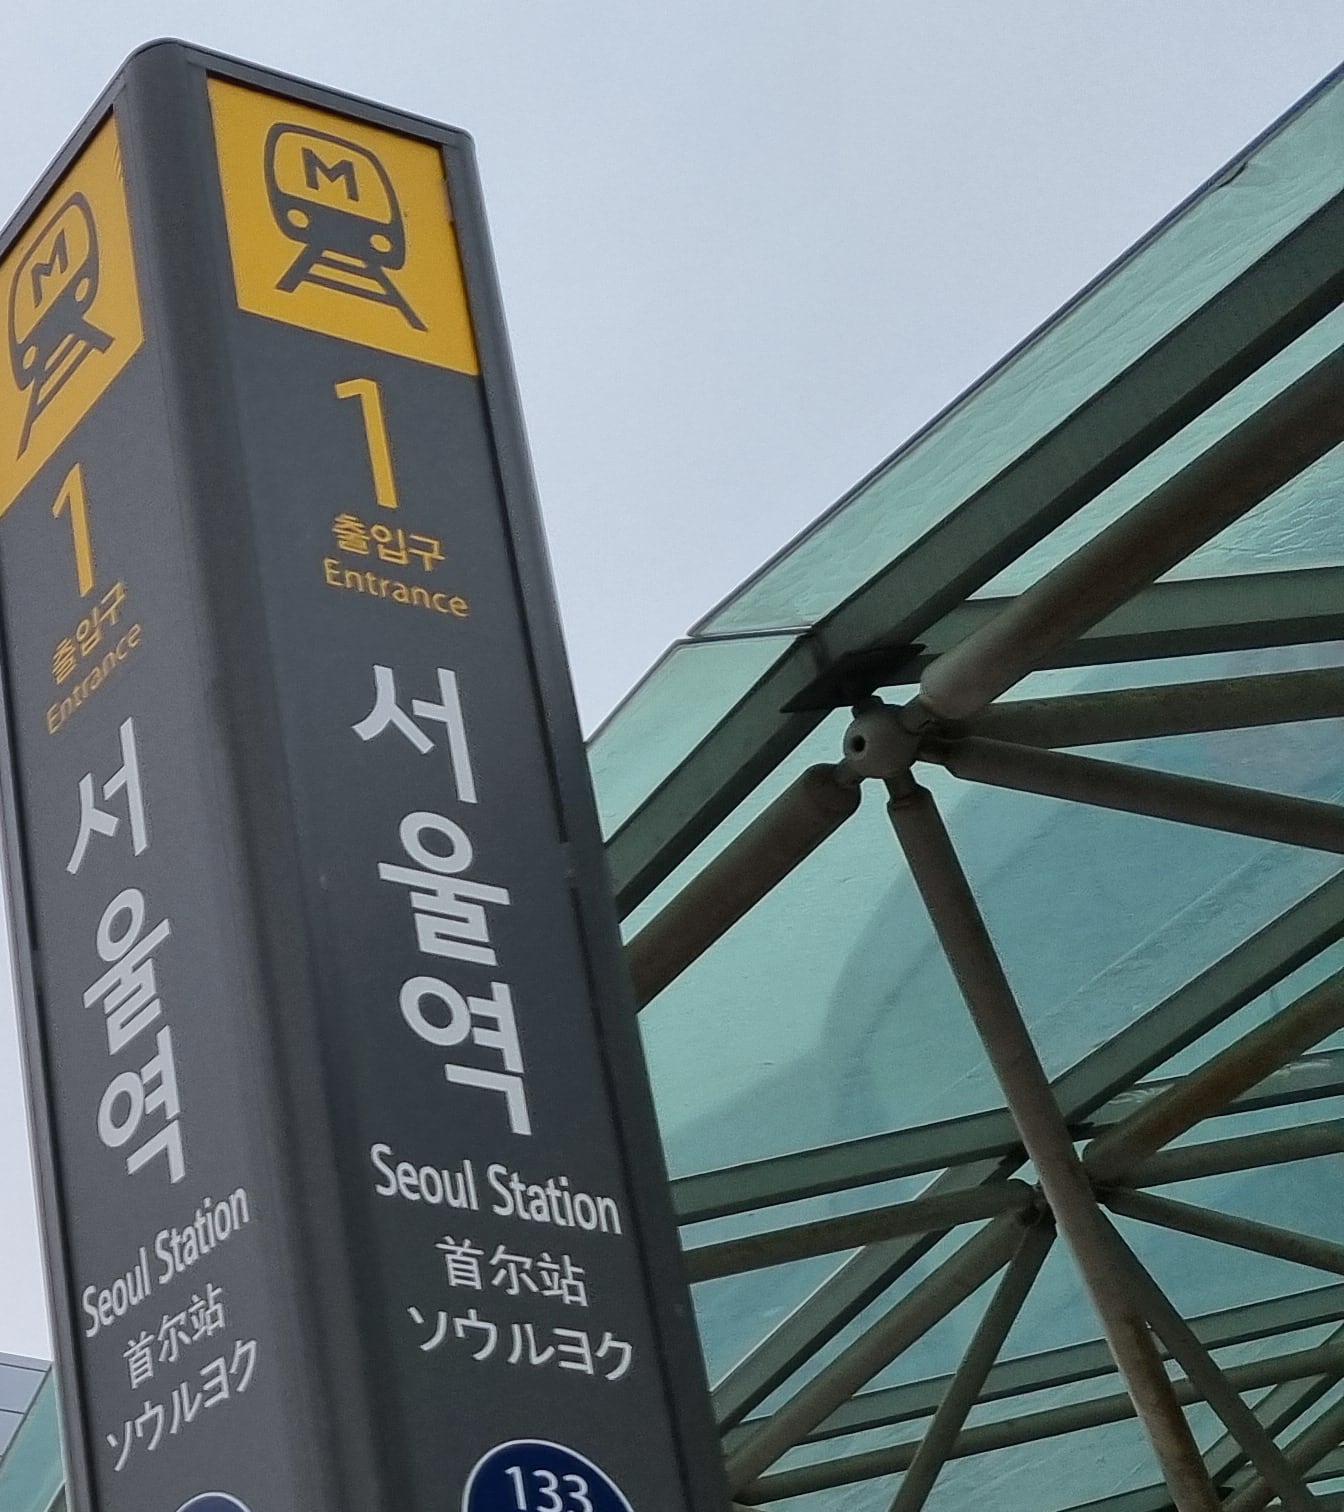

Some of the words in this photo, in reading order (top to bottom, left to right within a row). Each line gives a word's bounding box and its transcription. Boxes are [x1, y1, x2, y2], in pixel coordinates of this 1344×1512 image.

[335, 377, 398, 509] 1
[52, 462, 93, 598] 1
[333, 513, 445, 572] 출입구
[52, 579, 128, 686] 출입구
[323, 558, 470, 618] Entrance
[45, 623, 142, 735] Entrance
[66, 716, 185, 1184] 서울역
[351, 664, 532, 1136] 서울역
[369, 1143, 479, 1212] Seoul
[487, 1163, 624, 1236] Station
[82, 1256, 152, 1338] Seoul
[157, 1188, 250, 1292] Station
[435, 1235, 589, 1307] 首尔站
[123, 1282, 227, 1390] 首尔站
[407, 1305, 634, 1382] ソウルヨク
[106, 1336, 259, 1471] ソウルヨク
